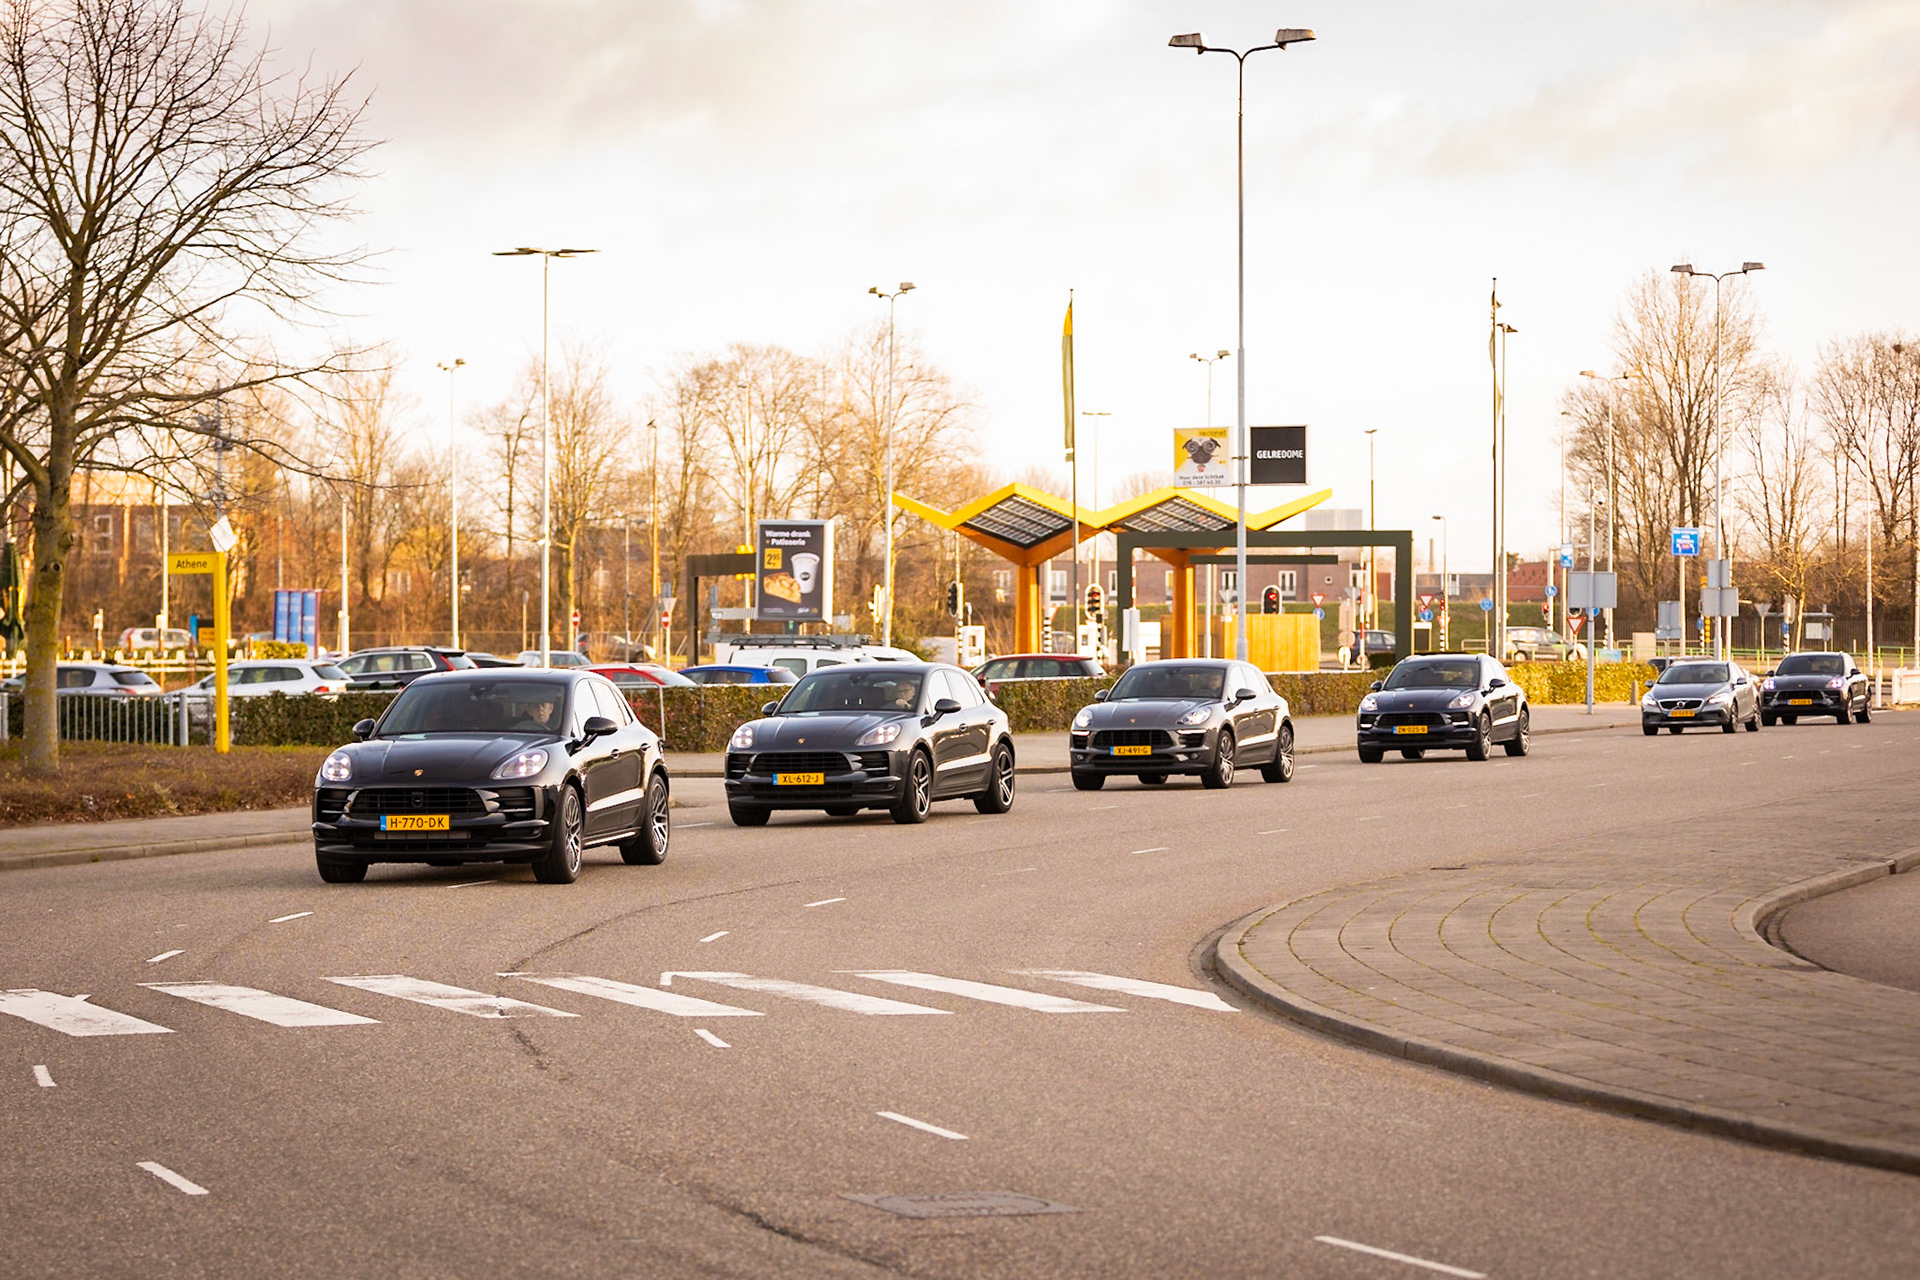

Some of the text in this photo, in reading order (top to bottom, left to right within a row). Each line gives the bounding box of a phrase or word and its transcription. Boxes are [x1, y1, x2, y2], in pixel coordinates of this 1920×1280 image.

[1256, 449, 1303, 459] GELREDOME
[771, 538, 806, 546] Patisserie
[176, 559, 207, 569] Athene
[1117, 746, 1148, 754] XJ-491-G
[782, 774, 819, 783] XL-612-J
[390, 817, 444, 828] H-770-DK
